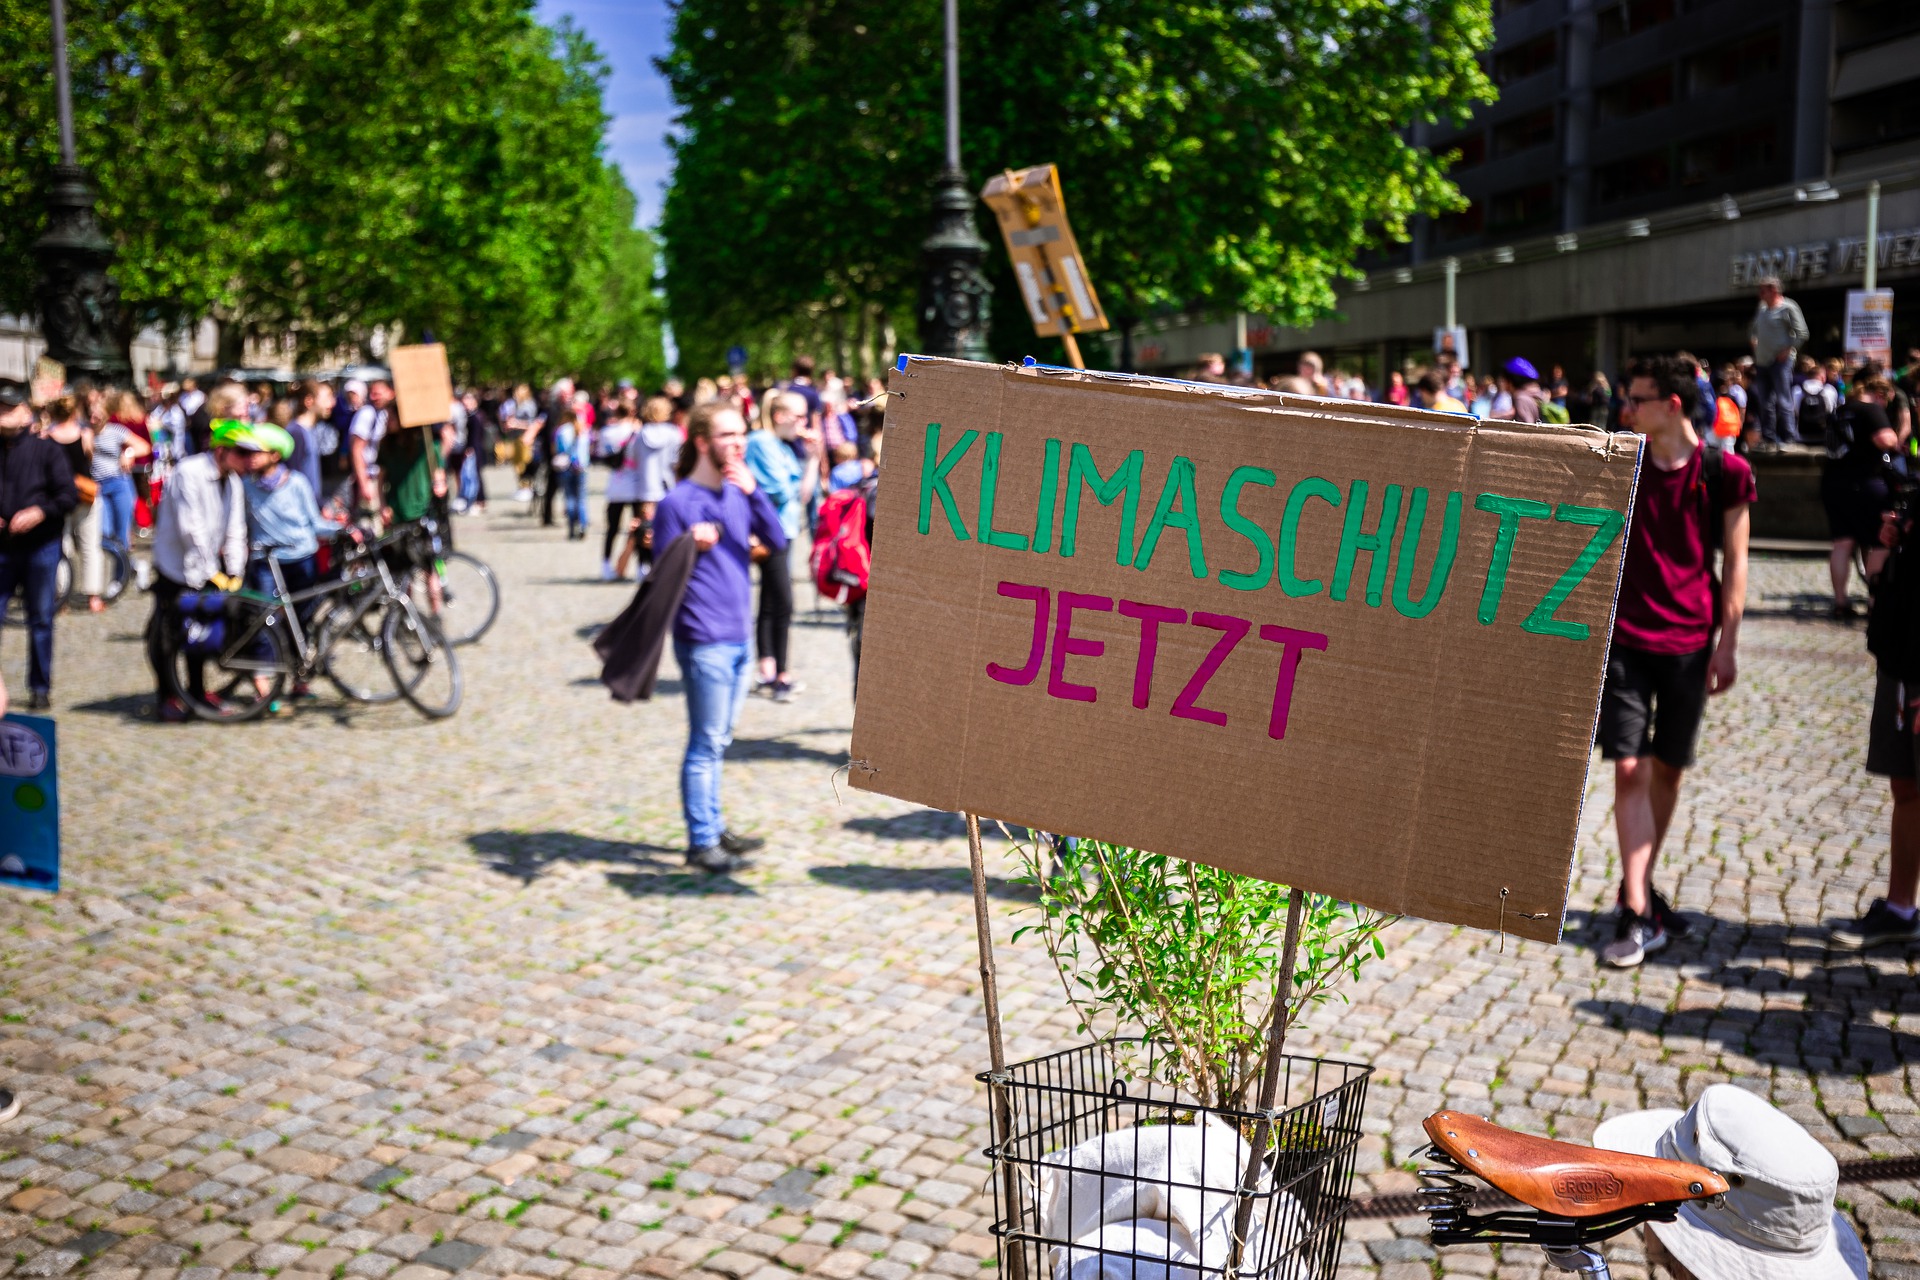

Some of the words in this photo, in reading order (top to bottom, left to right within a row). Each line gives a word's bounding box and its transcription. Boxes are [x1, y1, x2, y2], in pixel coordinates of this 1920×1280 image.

[917, 422, 1626, 641] KLIMASCHUTZ
[986, 581, 1329, 740] JETZT
[1558, 1181, 1614, 1195] BROOKS
